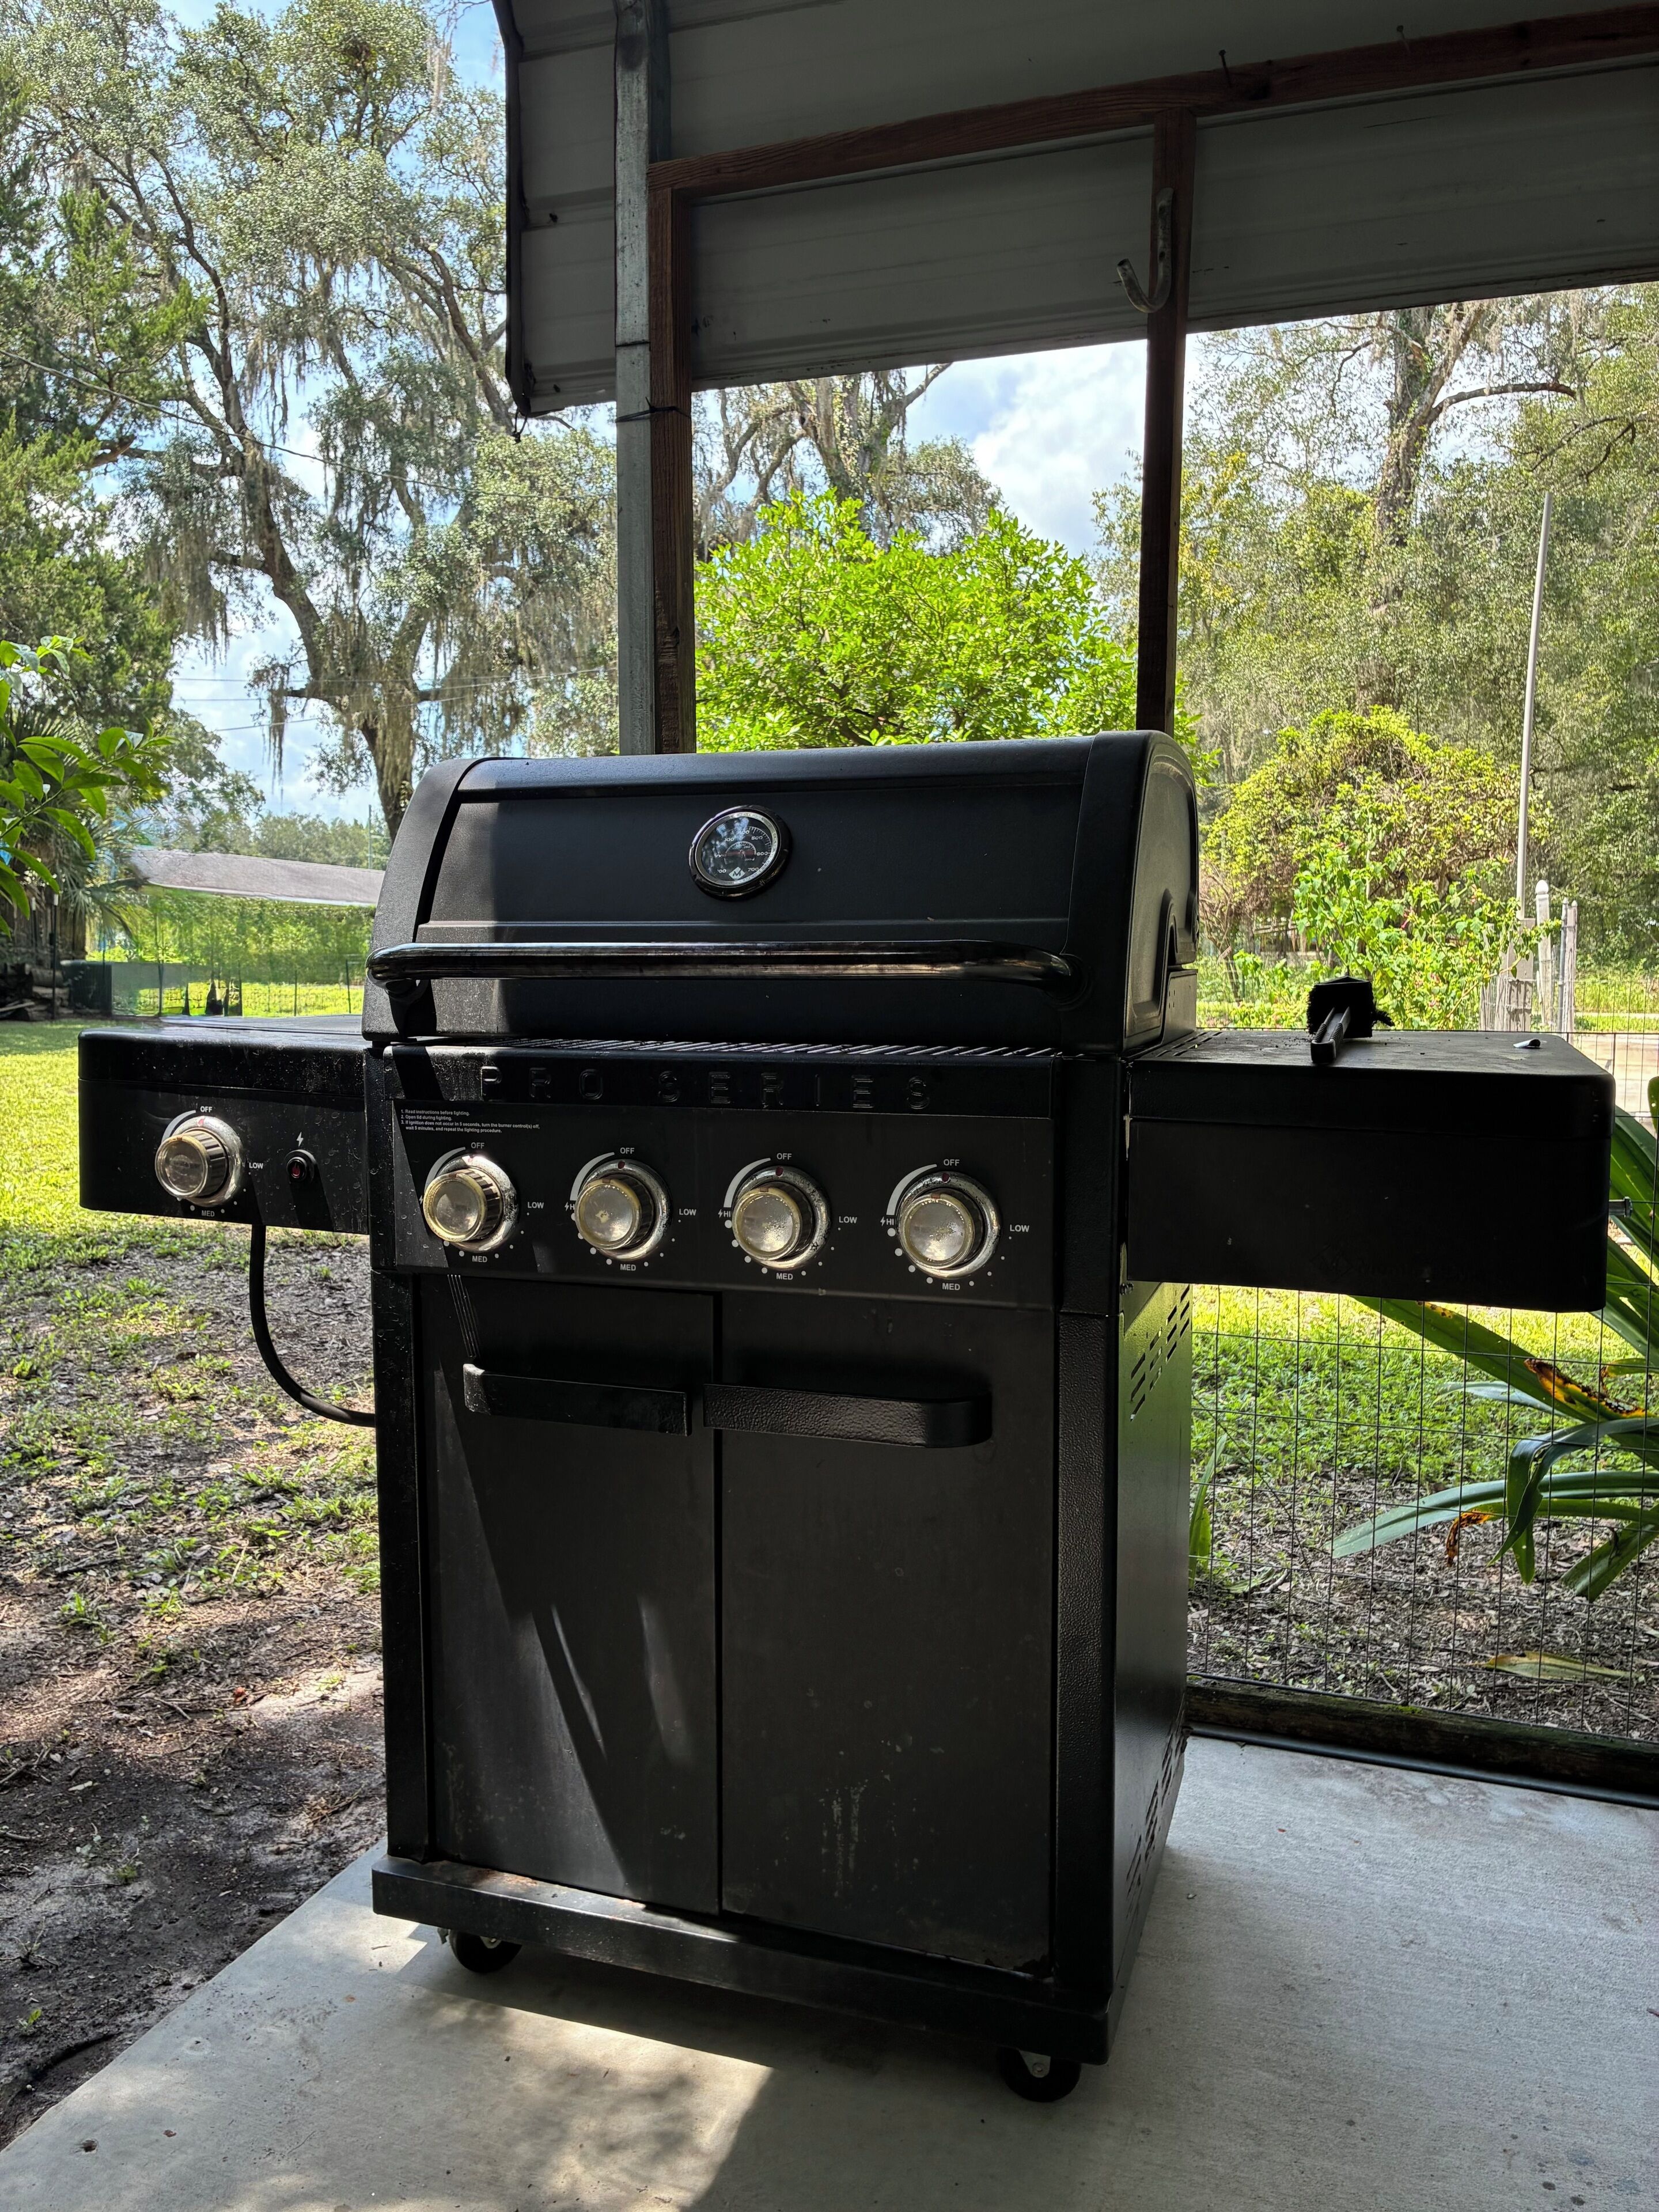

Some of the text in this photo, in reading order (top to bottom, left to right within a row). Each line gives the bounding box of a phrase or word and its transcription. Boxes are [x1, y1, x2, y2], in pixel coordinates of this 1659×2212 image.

[480, 1065, 931, 1110] PRO SERIES
[943, 1158, 960, 1166] OFF
[1009, 1224, 1030, 1232] LOW
[620, 1263, 636, 1271] MED
[776, 1272, 793, 1281] MED
[942, 1282, 960, 1291] MED
